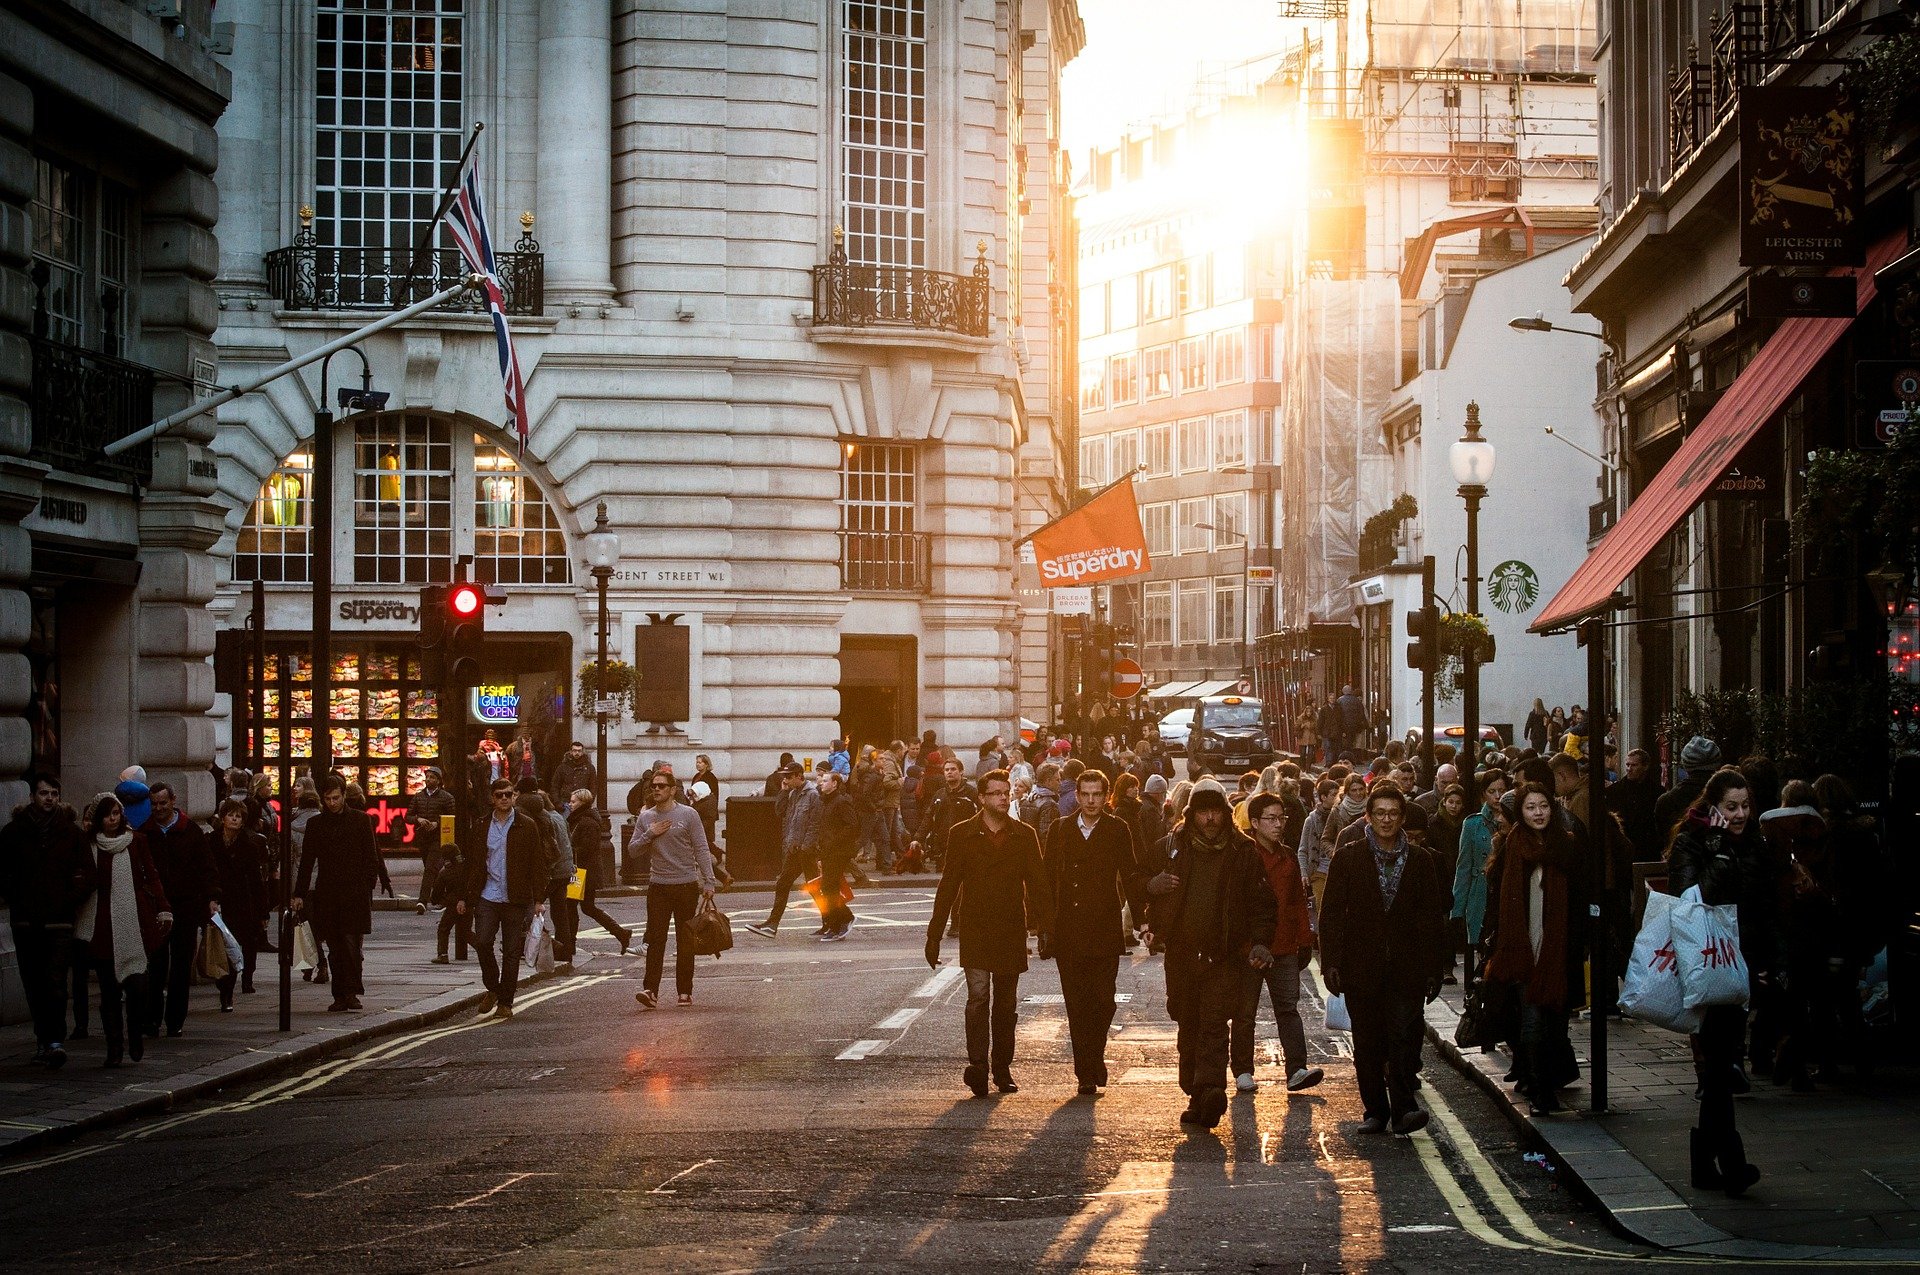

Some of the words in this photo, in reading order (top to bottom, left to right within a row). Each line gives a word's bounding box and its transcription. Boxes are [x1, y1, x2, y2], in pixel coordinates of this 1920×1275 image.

[1764, 237, 1844, 248] LEICESTER
[1784, 251, 1825, 261] ARMS
[1041, 547, 1143, 580] Superdry
[610, 571, 648, 581] GENT
[658, 571, 701, 581] STREET
[339, 601, 421, 624] Superdry
[1701, 935, 1738, 970] H&M
